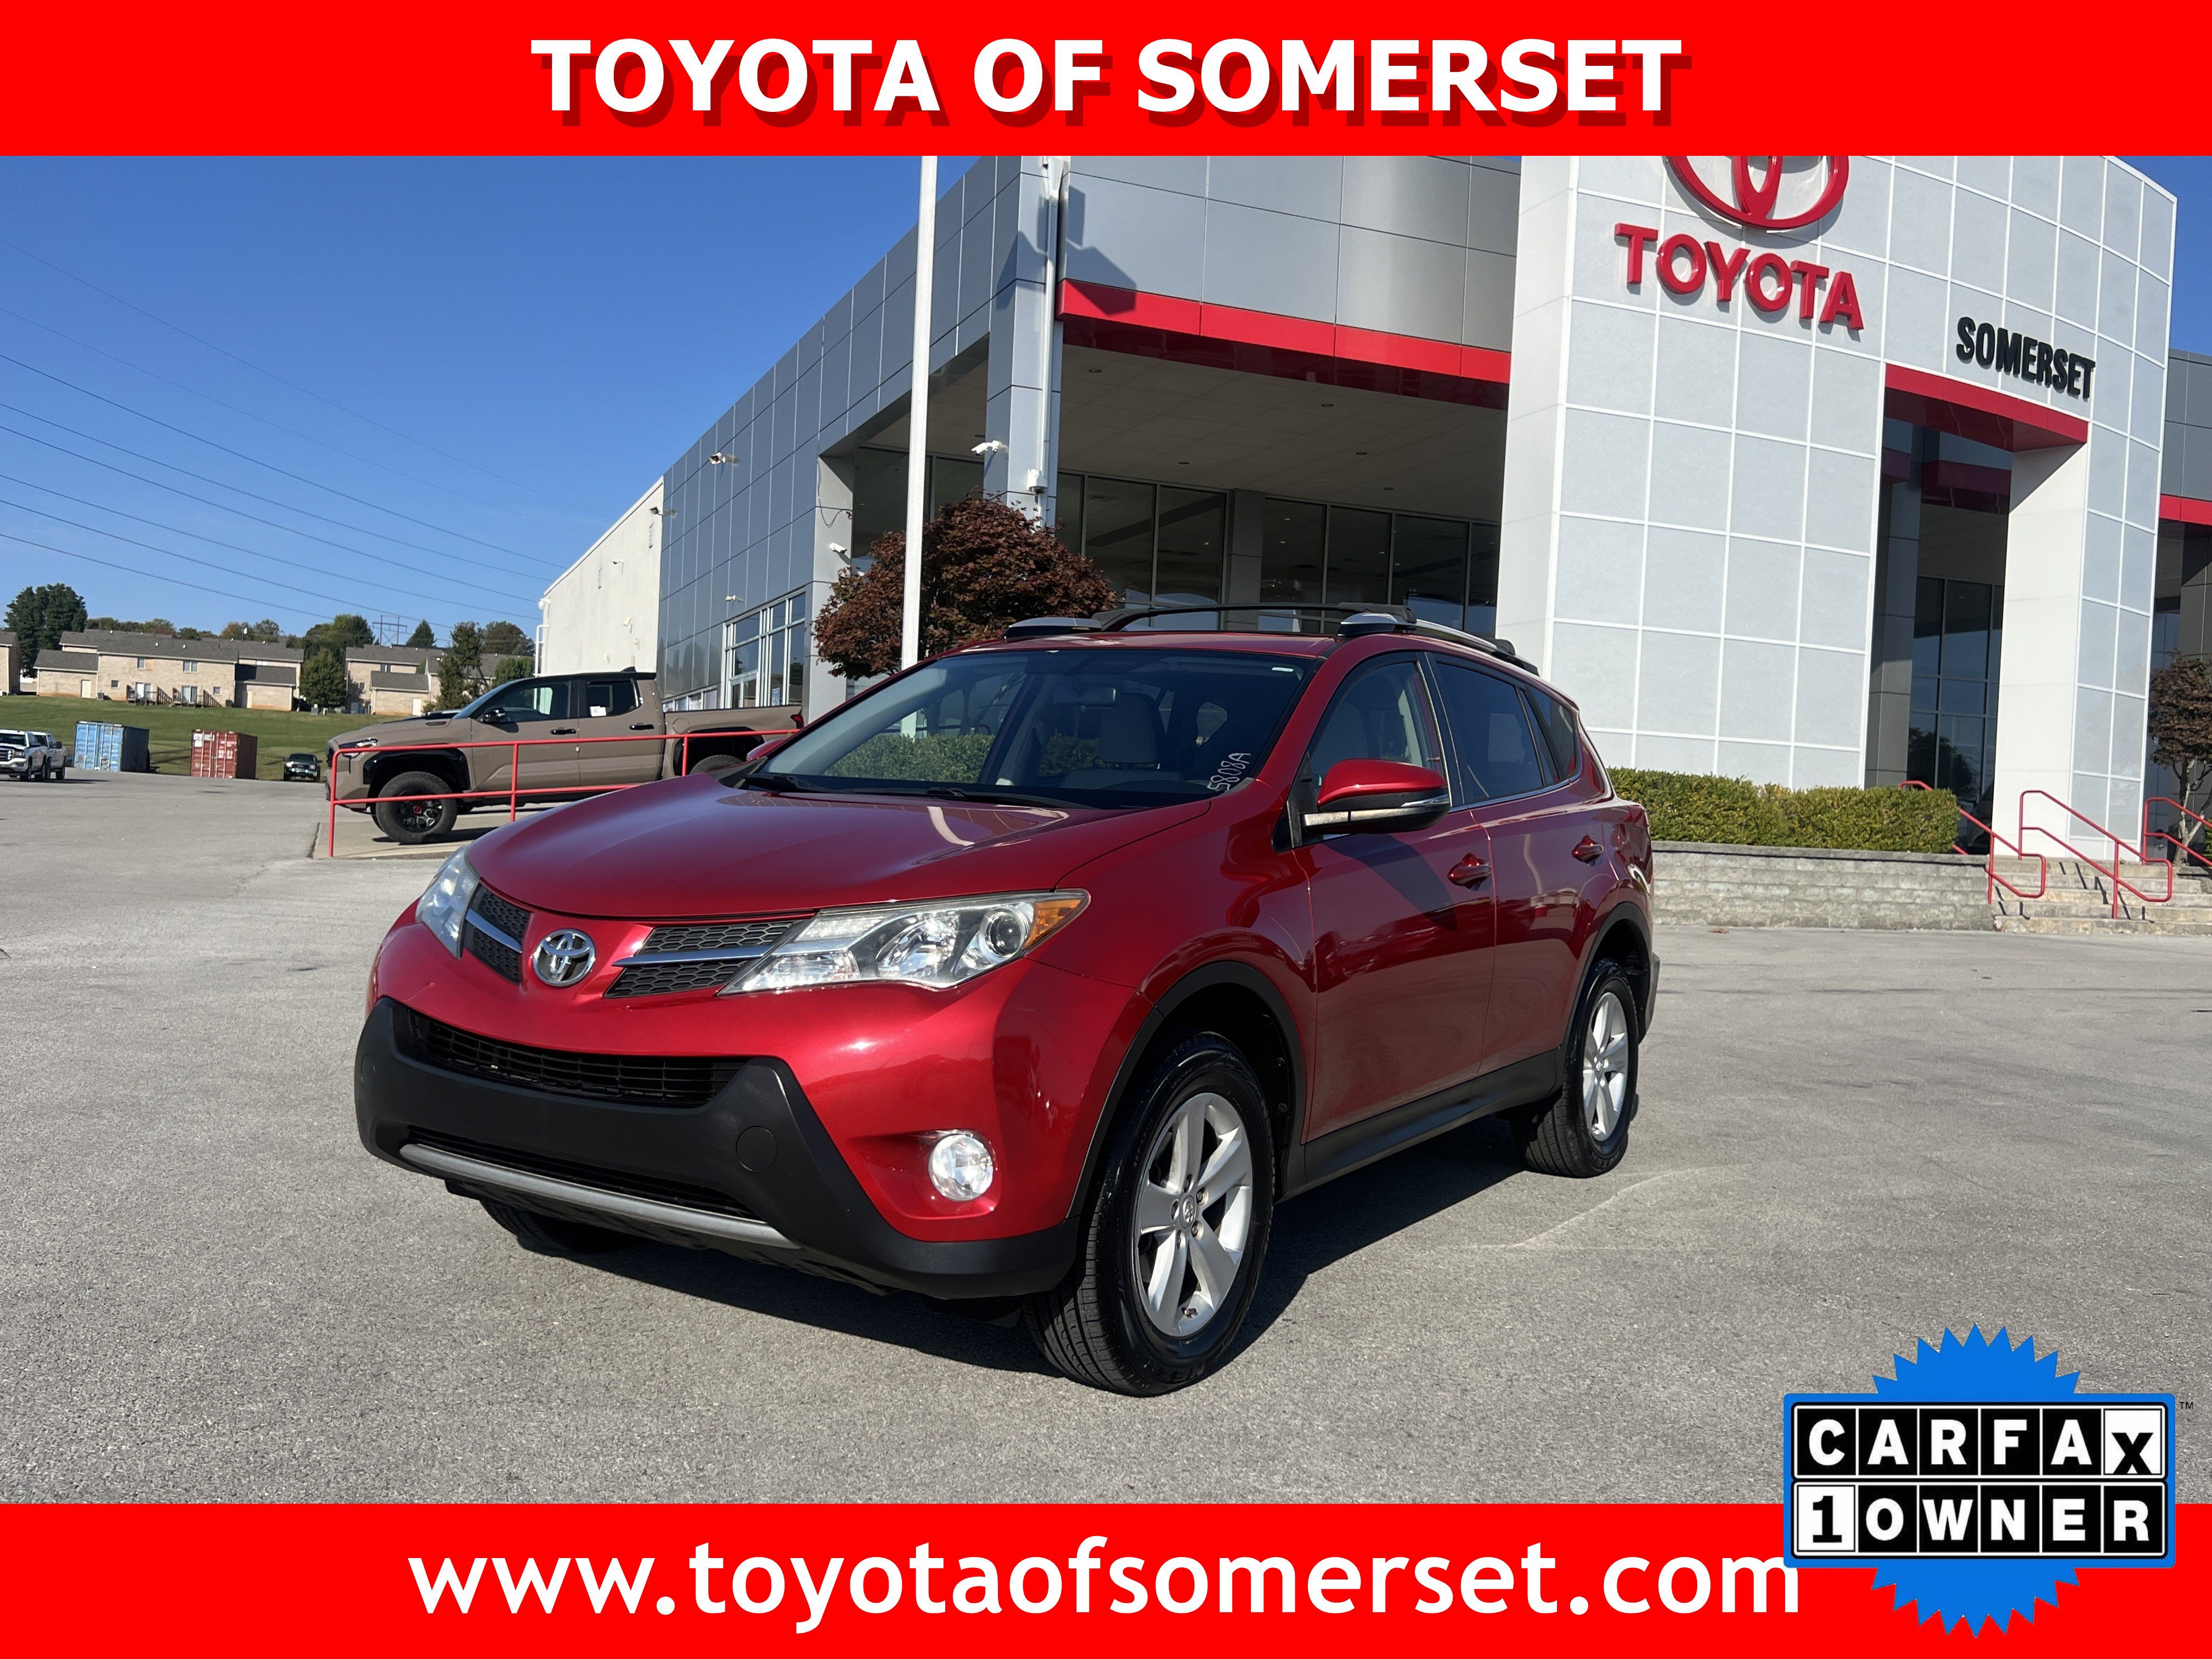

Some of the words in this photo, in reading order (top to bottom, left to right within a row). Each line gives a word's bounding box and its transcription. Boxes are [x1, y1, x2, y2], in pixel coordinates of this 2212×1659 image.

[1614, 223, 1864, 330] TOYOTA
[1956, 315, 2096, 400] SOMERSET
[1207, 752, 1251, 792] 5808A
